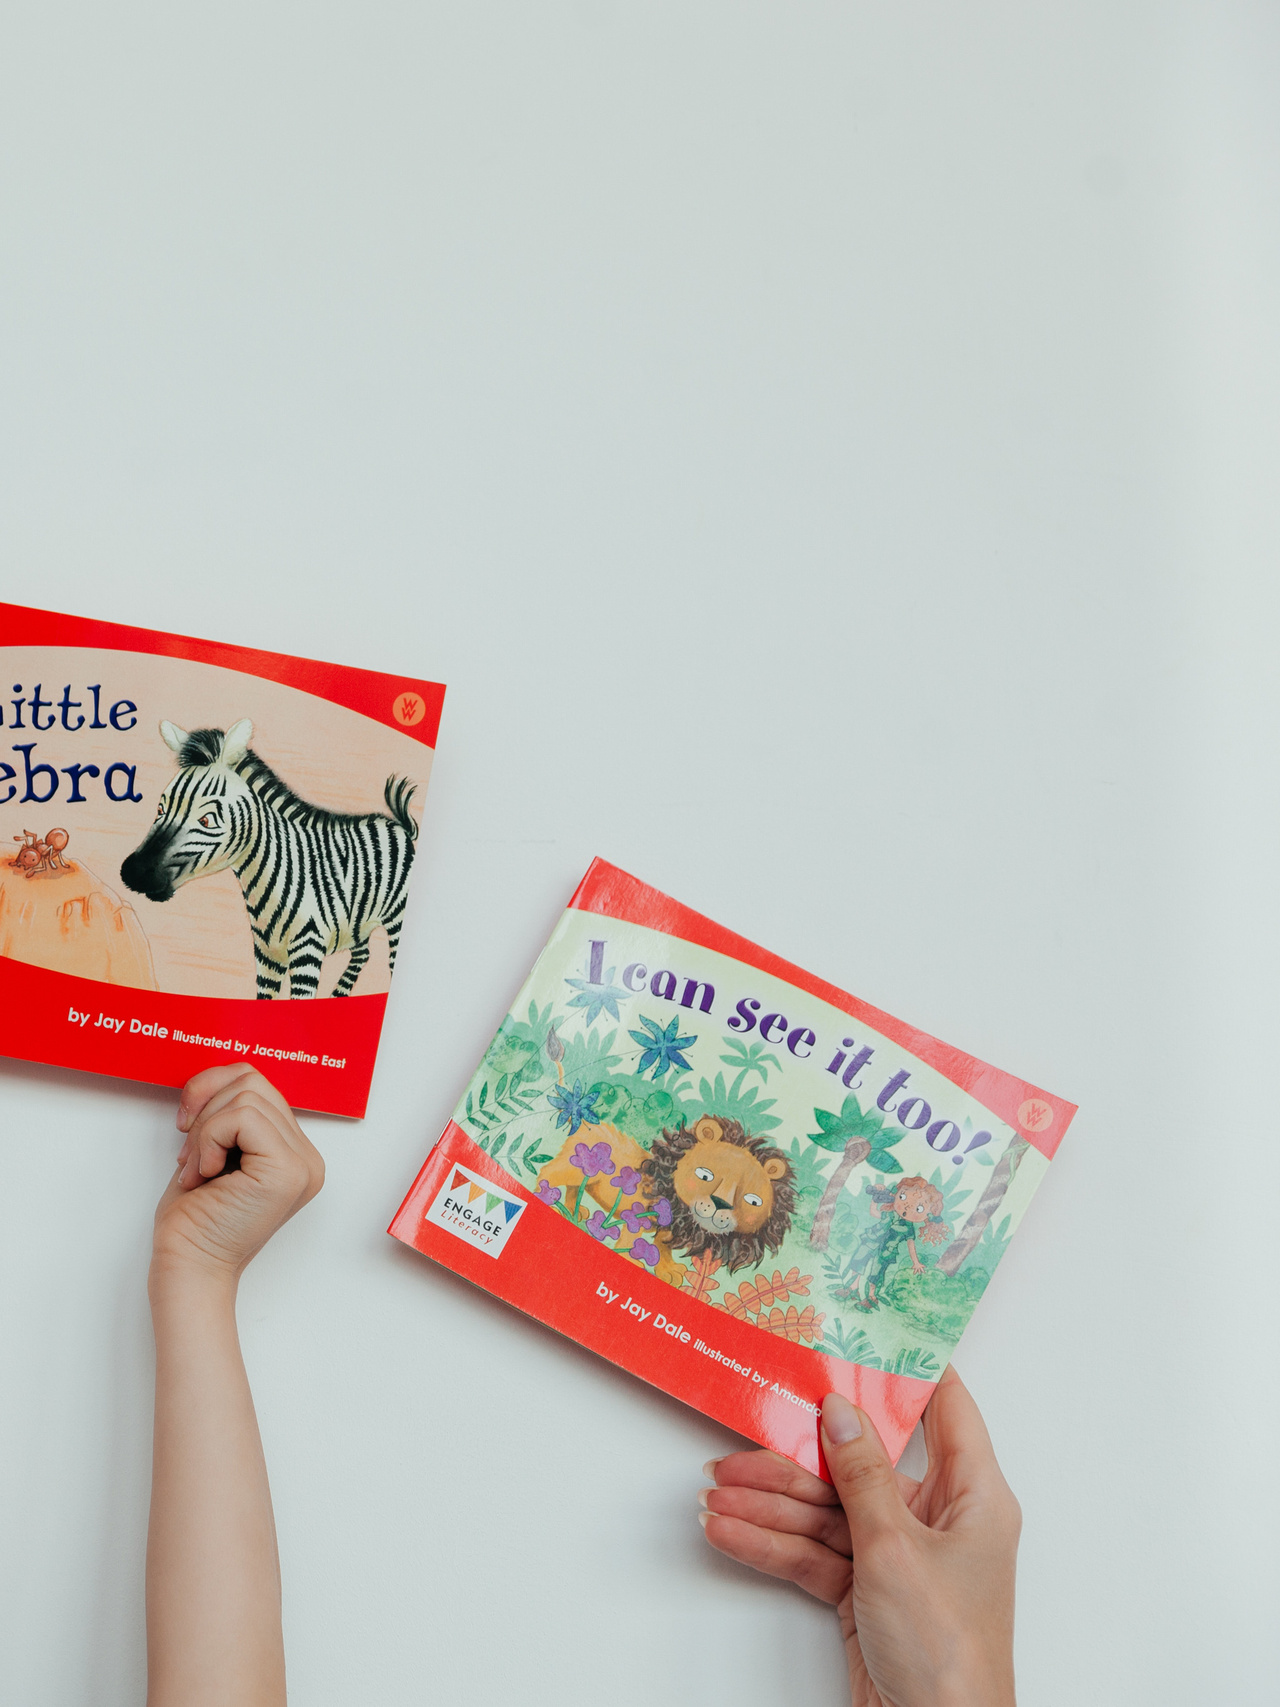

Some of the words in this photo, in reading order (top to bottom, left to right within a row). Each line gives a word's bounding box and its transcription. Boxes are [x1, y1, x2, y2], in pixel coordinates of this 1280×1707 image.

[67, 1007, 90, 1027] by
[94, 1013, 125, 1033] Jay
[129, 1018, 169, 1039] Dale
[172, 1029, 232, 1050] illustrated
[234, 1040, 250, 1055] by
[252, 1044, 319, 1064] Jacqueline
[321, 1055, 346, 1069] East
[586, 939, 608, 985] I
[622, 963, 716, 1015] can
[727, 997, 817, 1058] see
[824, 1037, 875, 1090] it
[876, 1068, 992, 1166] too!
[440, 1209, 494, 1245] Literacy
[443, 1197, 502, 1237] ENGAGE
[595, 1281, 620, 1304] by
[620, 1297, 652, 1322] Jay
[653, 1313, 692, 1344] Dale
[693, 1338, 752, 1378] illustrated
[751, 1371, 769, 1388] by
[769, 1382, 823, 1417] Amanda
